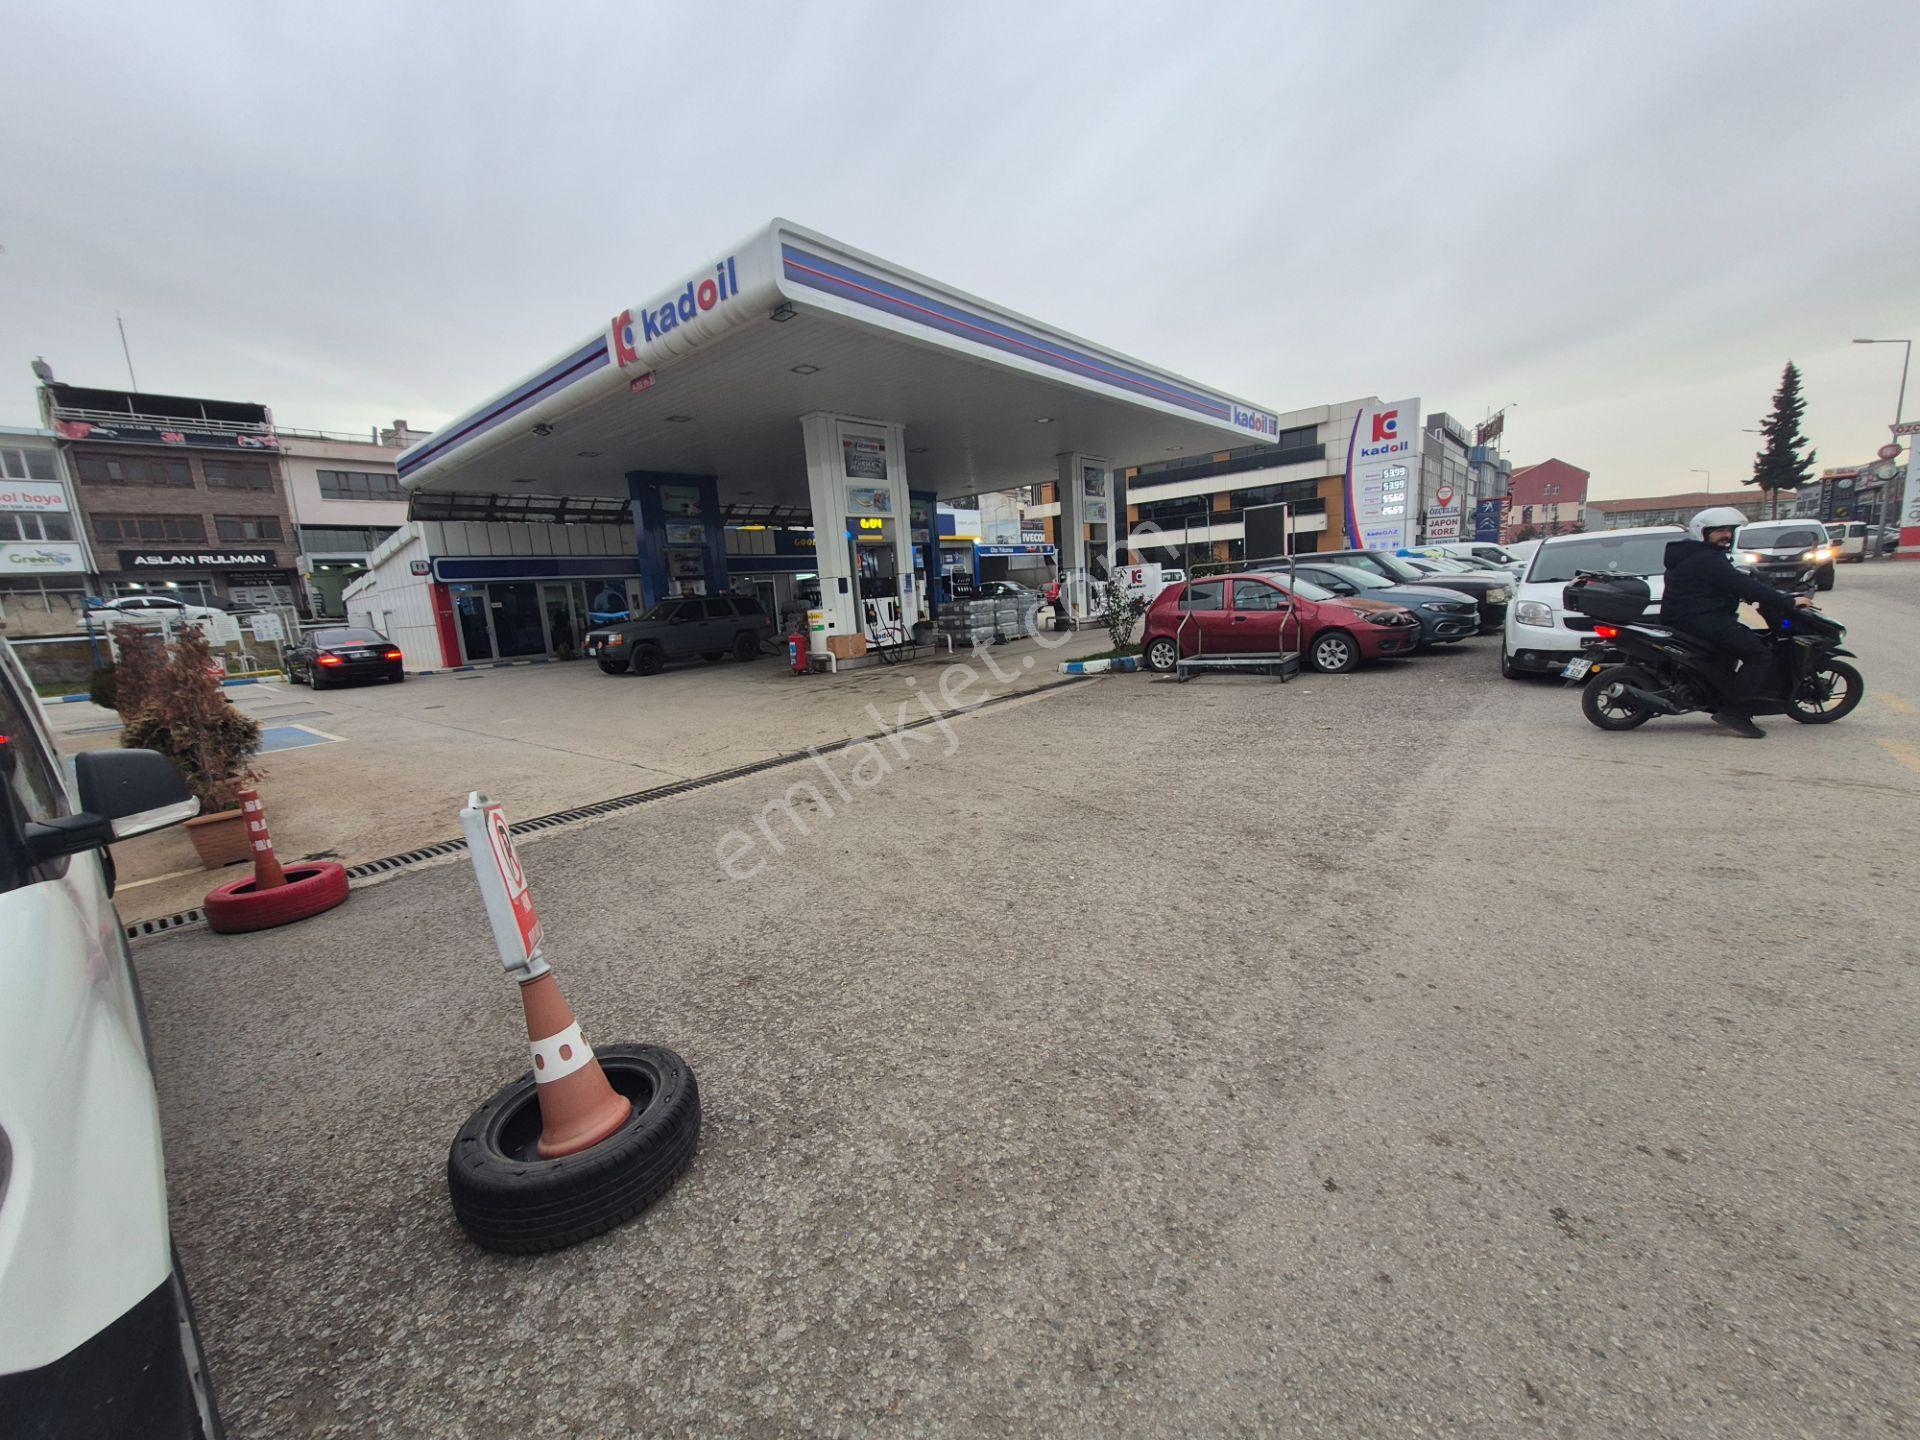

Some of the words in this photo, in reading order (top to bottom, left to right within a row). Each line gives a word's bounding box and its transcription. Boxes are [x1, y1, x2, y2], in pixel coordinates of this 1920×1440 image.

[641, 256, 739, 343] kadoil
[1233, 405, 1268, 434] kadoil
[161, 431, 186, 445] 3M
[1361, 441, 1409, 458] kadoil
[21, 492, 62, 506] boya
[1428, 518, 1458, 528] JAPON
[1430, 527, 1456, 536] KORE
[134, 555, 195, 566] ASLAN
[198, 554, 267, 565] RULMAN
